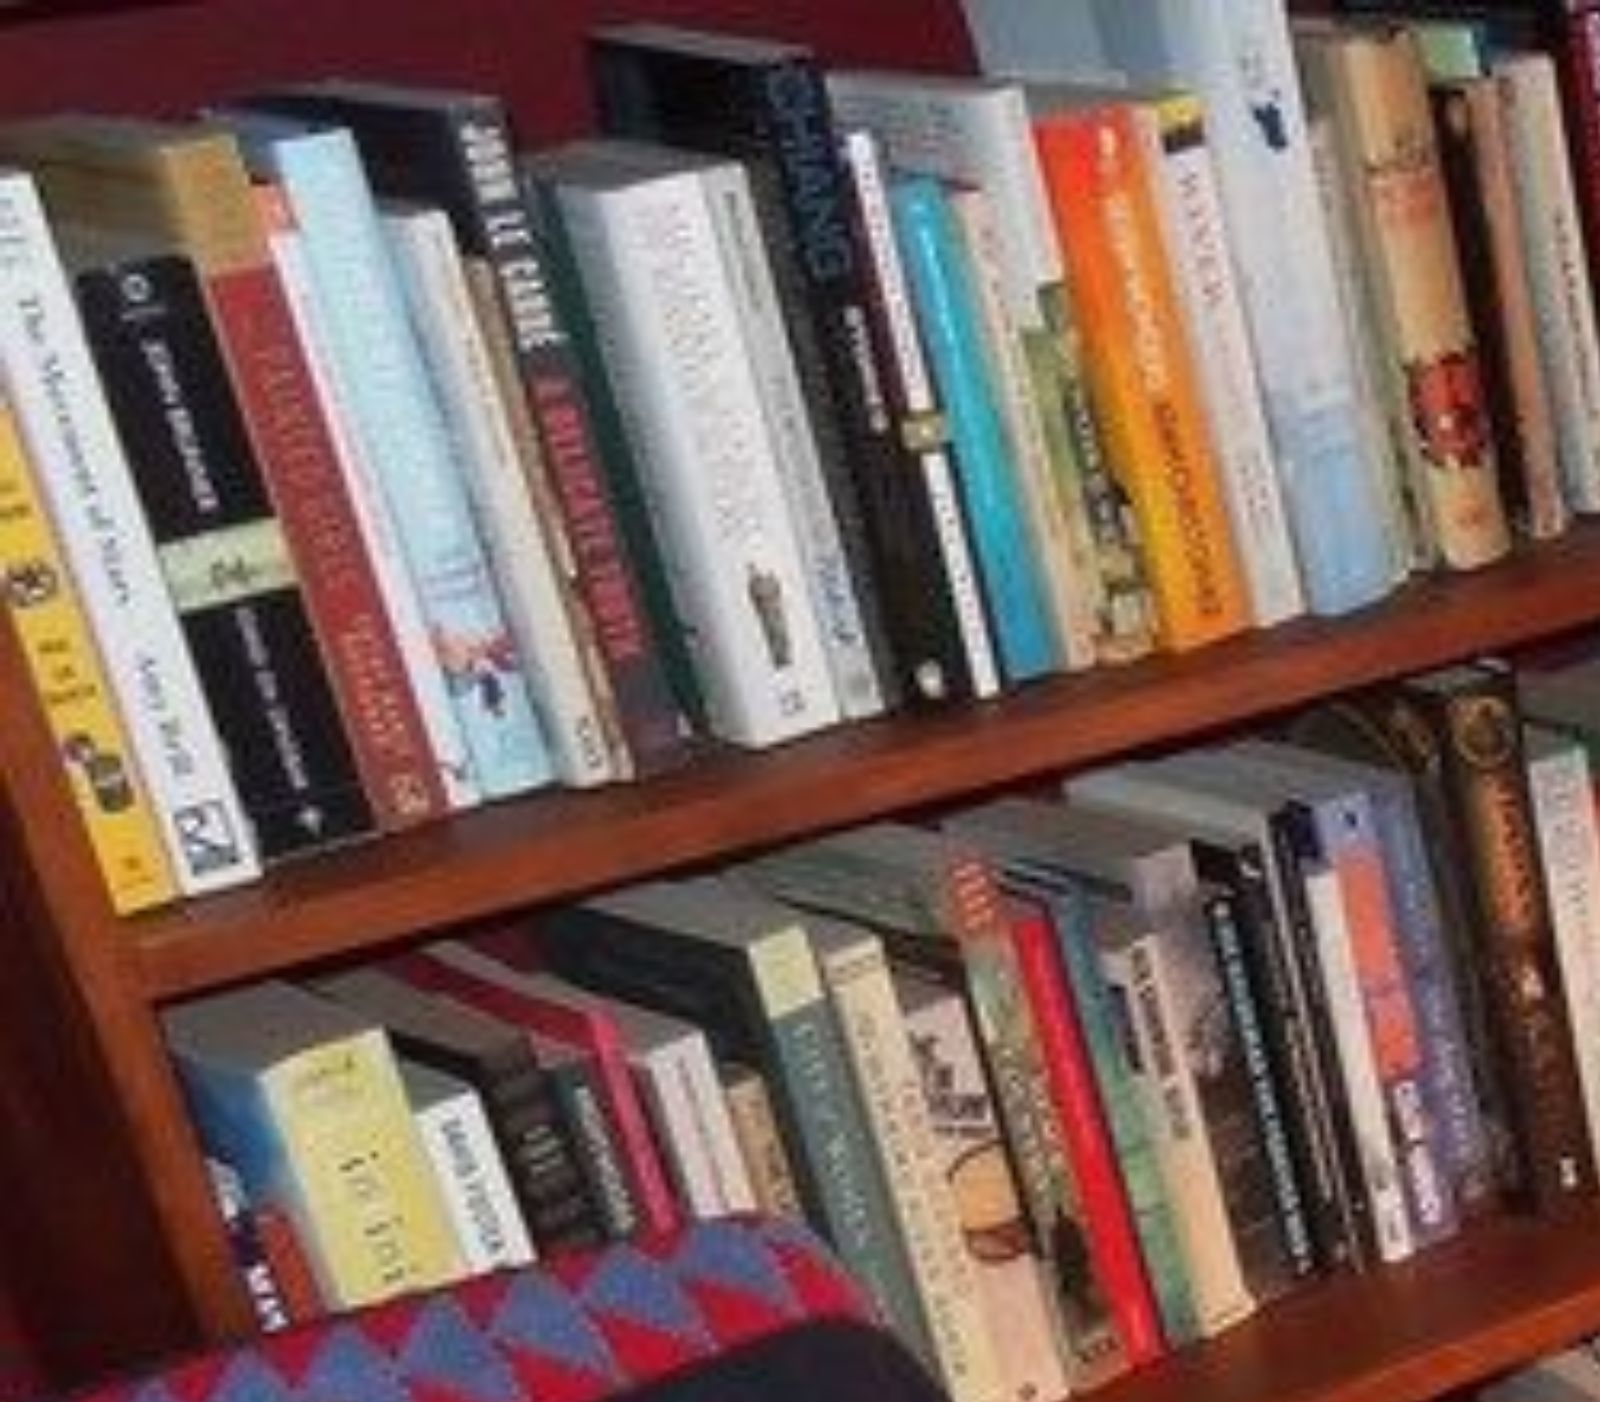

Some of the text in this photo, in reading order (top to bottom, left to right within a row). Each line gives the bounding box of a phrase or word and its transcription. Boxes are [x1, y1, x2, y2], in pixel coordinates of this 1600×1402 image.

[486, 206, 534, 253] LE
[763, 61, 859, 282] CHIANG
[14, 291, 54, 351] The
[36, 353, 108, 509] Movement
[100, 535, 145, 609] Stars
